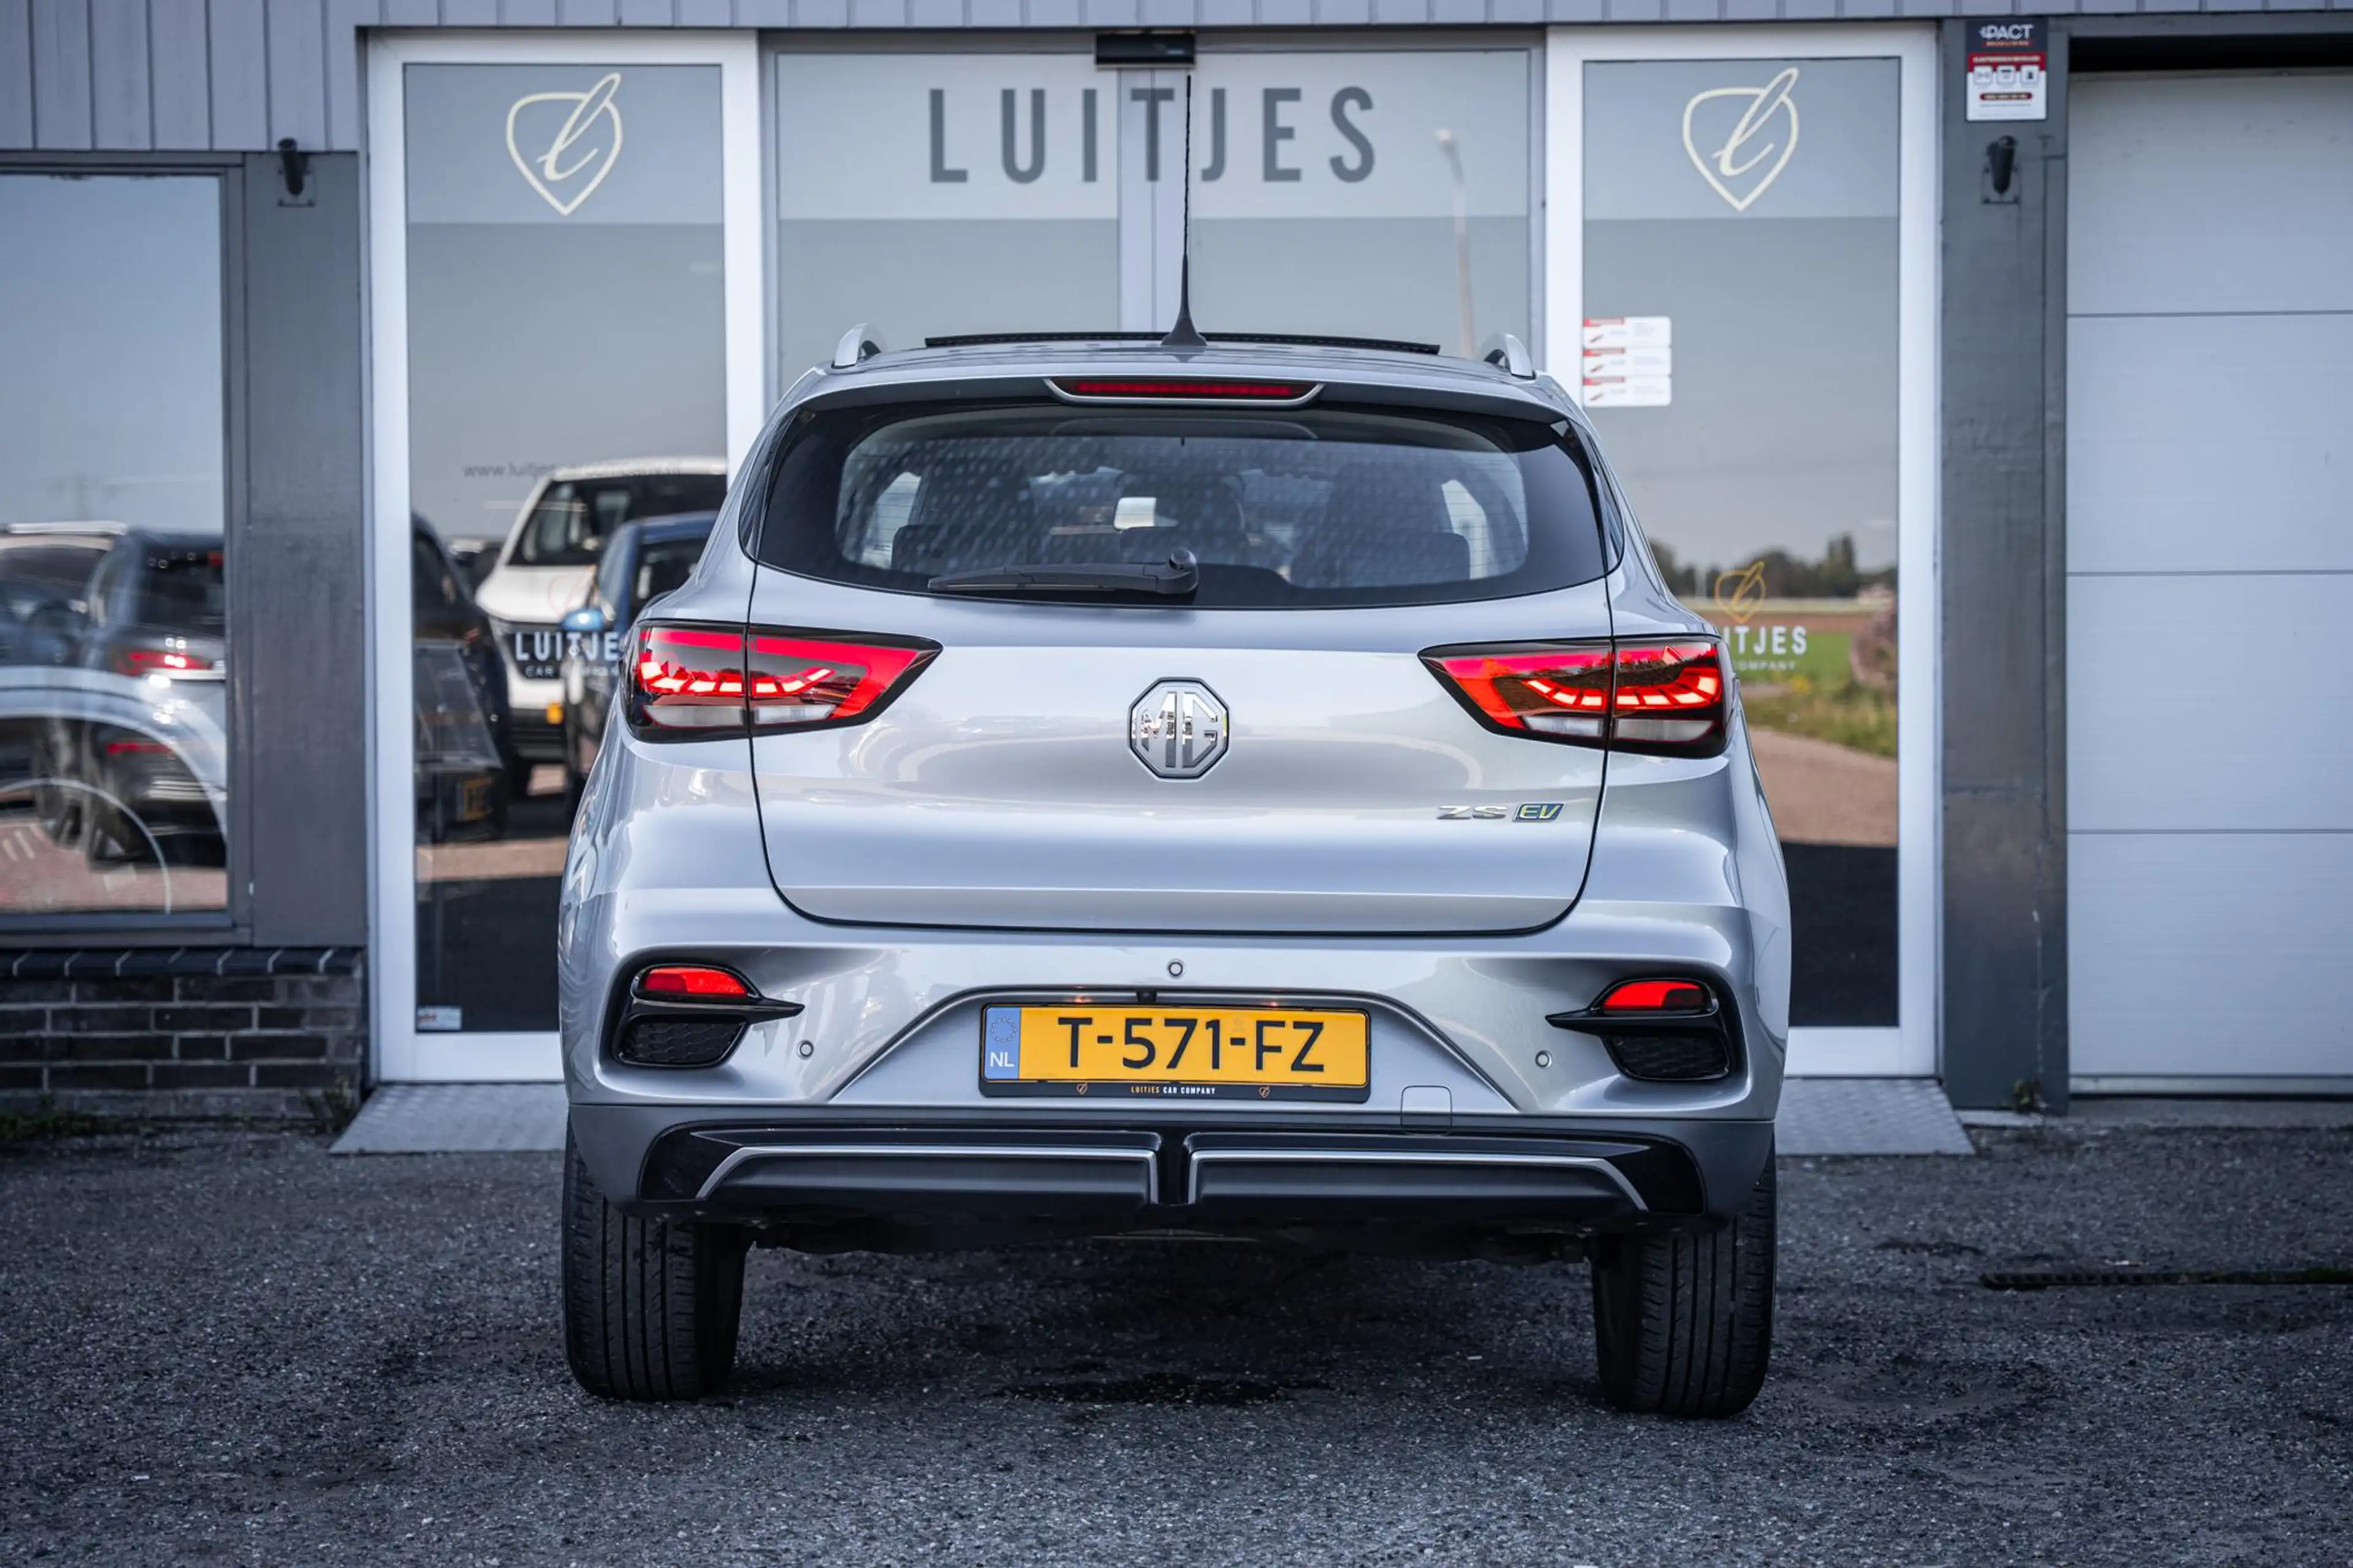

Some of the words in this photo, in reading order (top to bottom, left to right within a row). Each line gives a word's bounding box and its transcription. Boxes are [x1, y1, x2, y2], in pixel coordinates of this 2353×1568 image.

[929, 86, 1376, 184] LUITJES
[515, 631, 620, 662] LUITJE
[1722, 624, 1808, 656] ITJES
[525, 665, 555, 677] CAR
[1140, 691, 1219, 770] MG
[1436, 805, 1509, 820] ZS
[1517, 803, 1562, 820] EV
[990, 1051, 1015, 1067] NL
[1057, 1017, 1325, 1072] T-571-FZ
